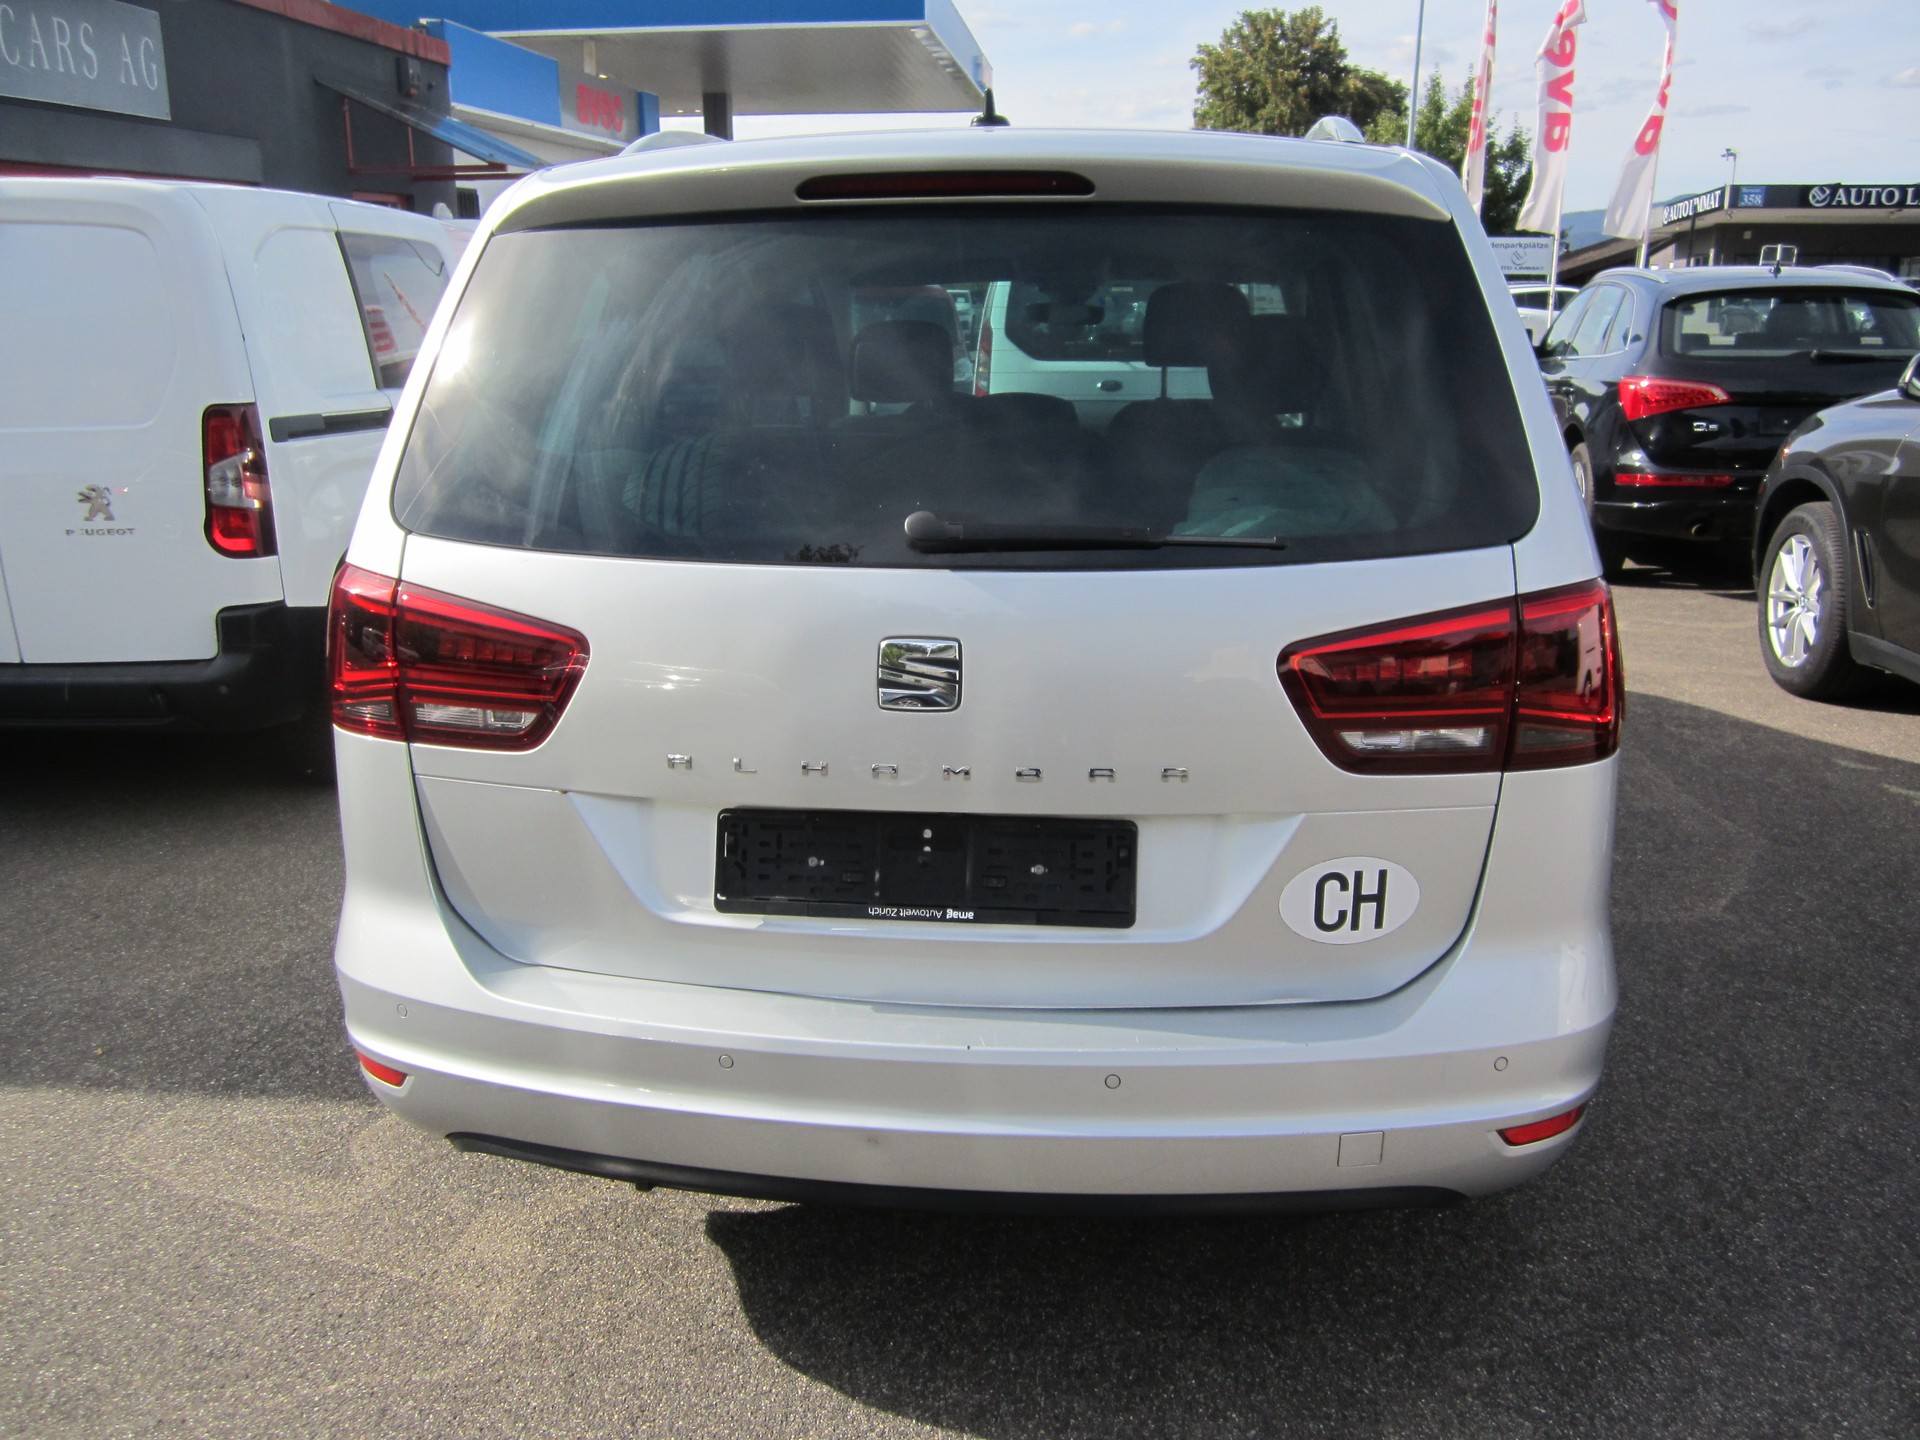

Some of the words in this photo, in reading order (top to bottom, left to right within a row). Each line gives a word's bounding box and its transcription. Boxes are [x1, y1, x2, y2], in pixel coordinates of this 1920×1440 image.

[0, 4, 98, 79] CARS
[121, 33, 158, 90] AG
[1740, 194, 1762, 205] 358
[1831, 187, 1899, 206] AUTO
[1905, 187, 1920, 206] L
[1668, 199, 1689, 221] AUTO
[1313, 869, 1388, 933] CH
[868, 906, 898, 917] Zürich
[899, 908, 943, 918] Autowelt
[946, 908, 975, 920] amag
